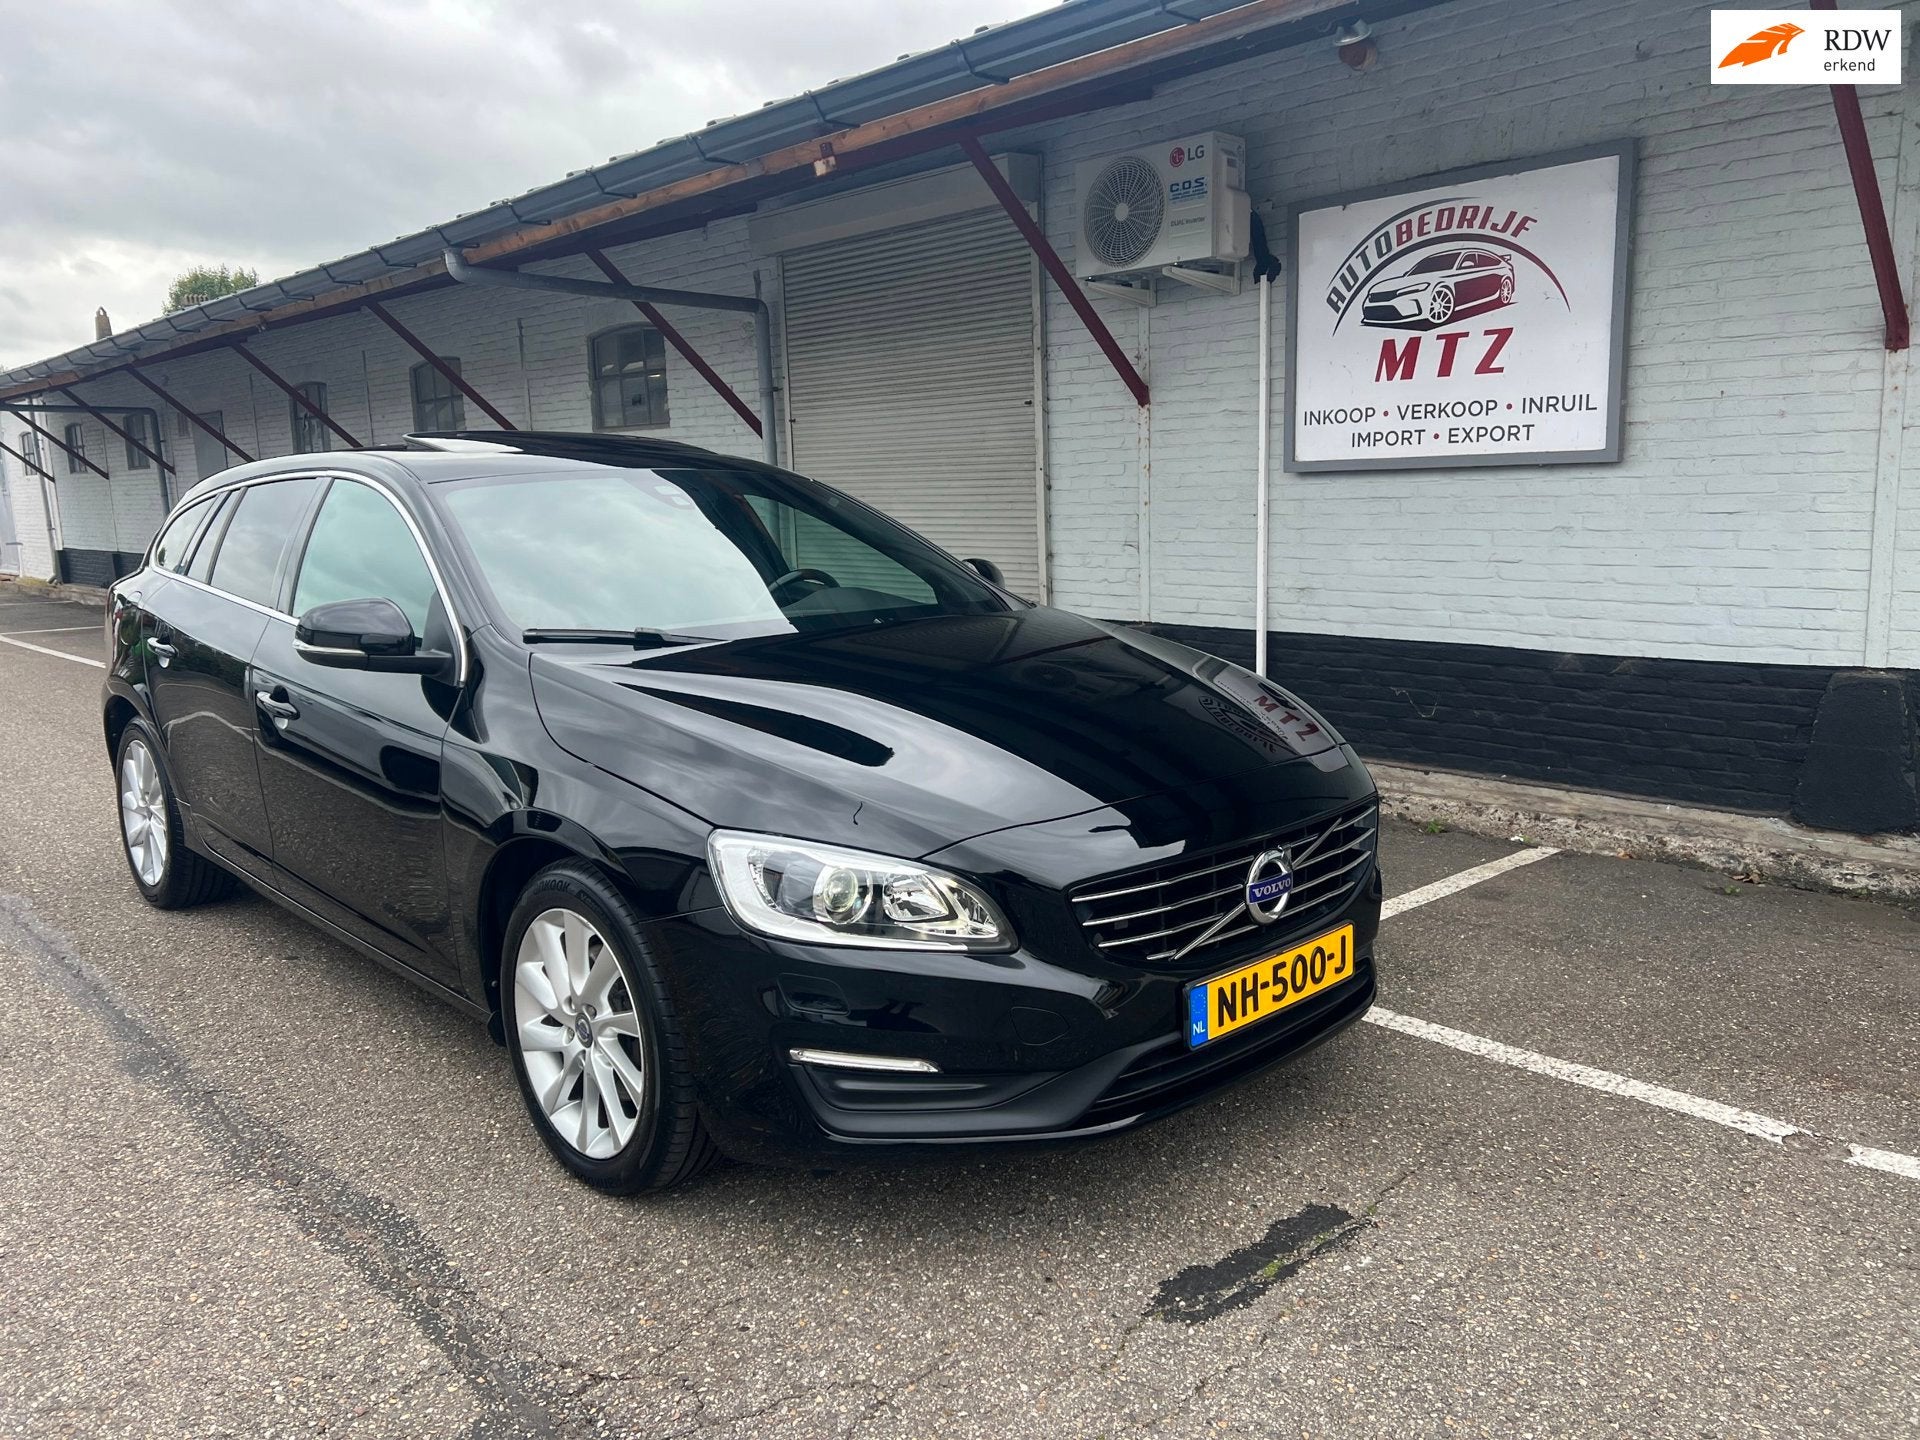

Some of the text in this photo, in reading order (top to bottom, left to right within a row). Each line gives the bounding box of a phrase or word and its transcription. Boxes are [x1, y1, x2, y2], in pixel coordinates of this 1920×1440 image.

[1188, 145, 1205, 162] LG
[1326, 206, 1537, 314] AUTOBEDRIJF
[1375, 327, 1514, 382] MTZ
[1303, 394, 1598, 426] INKOOP VERKOOP INRUIL
[1351, 424, 1535, 448] IMPORT EXPORT
[1252, 878, 1291, 898] VOLVO
[1217, 935, 1346, 1028] NH-500-J
[1192, 1021, 1206, 1036] NL
